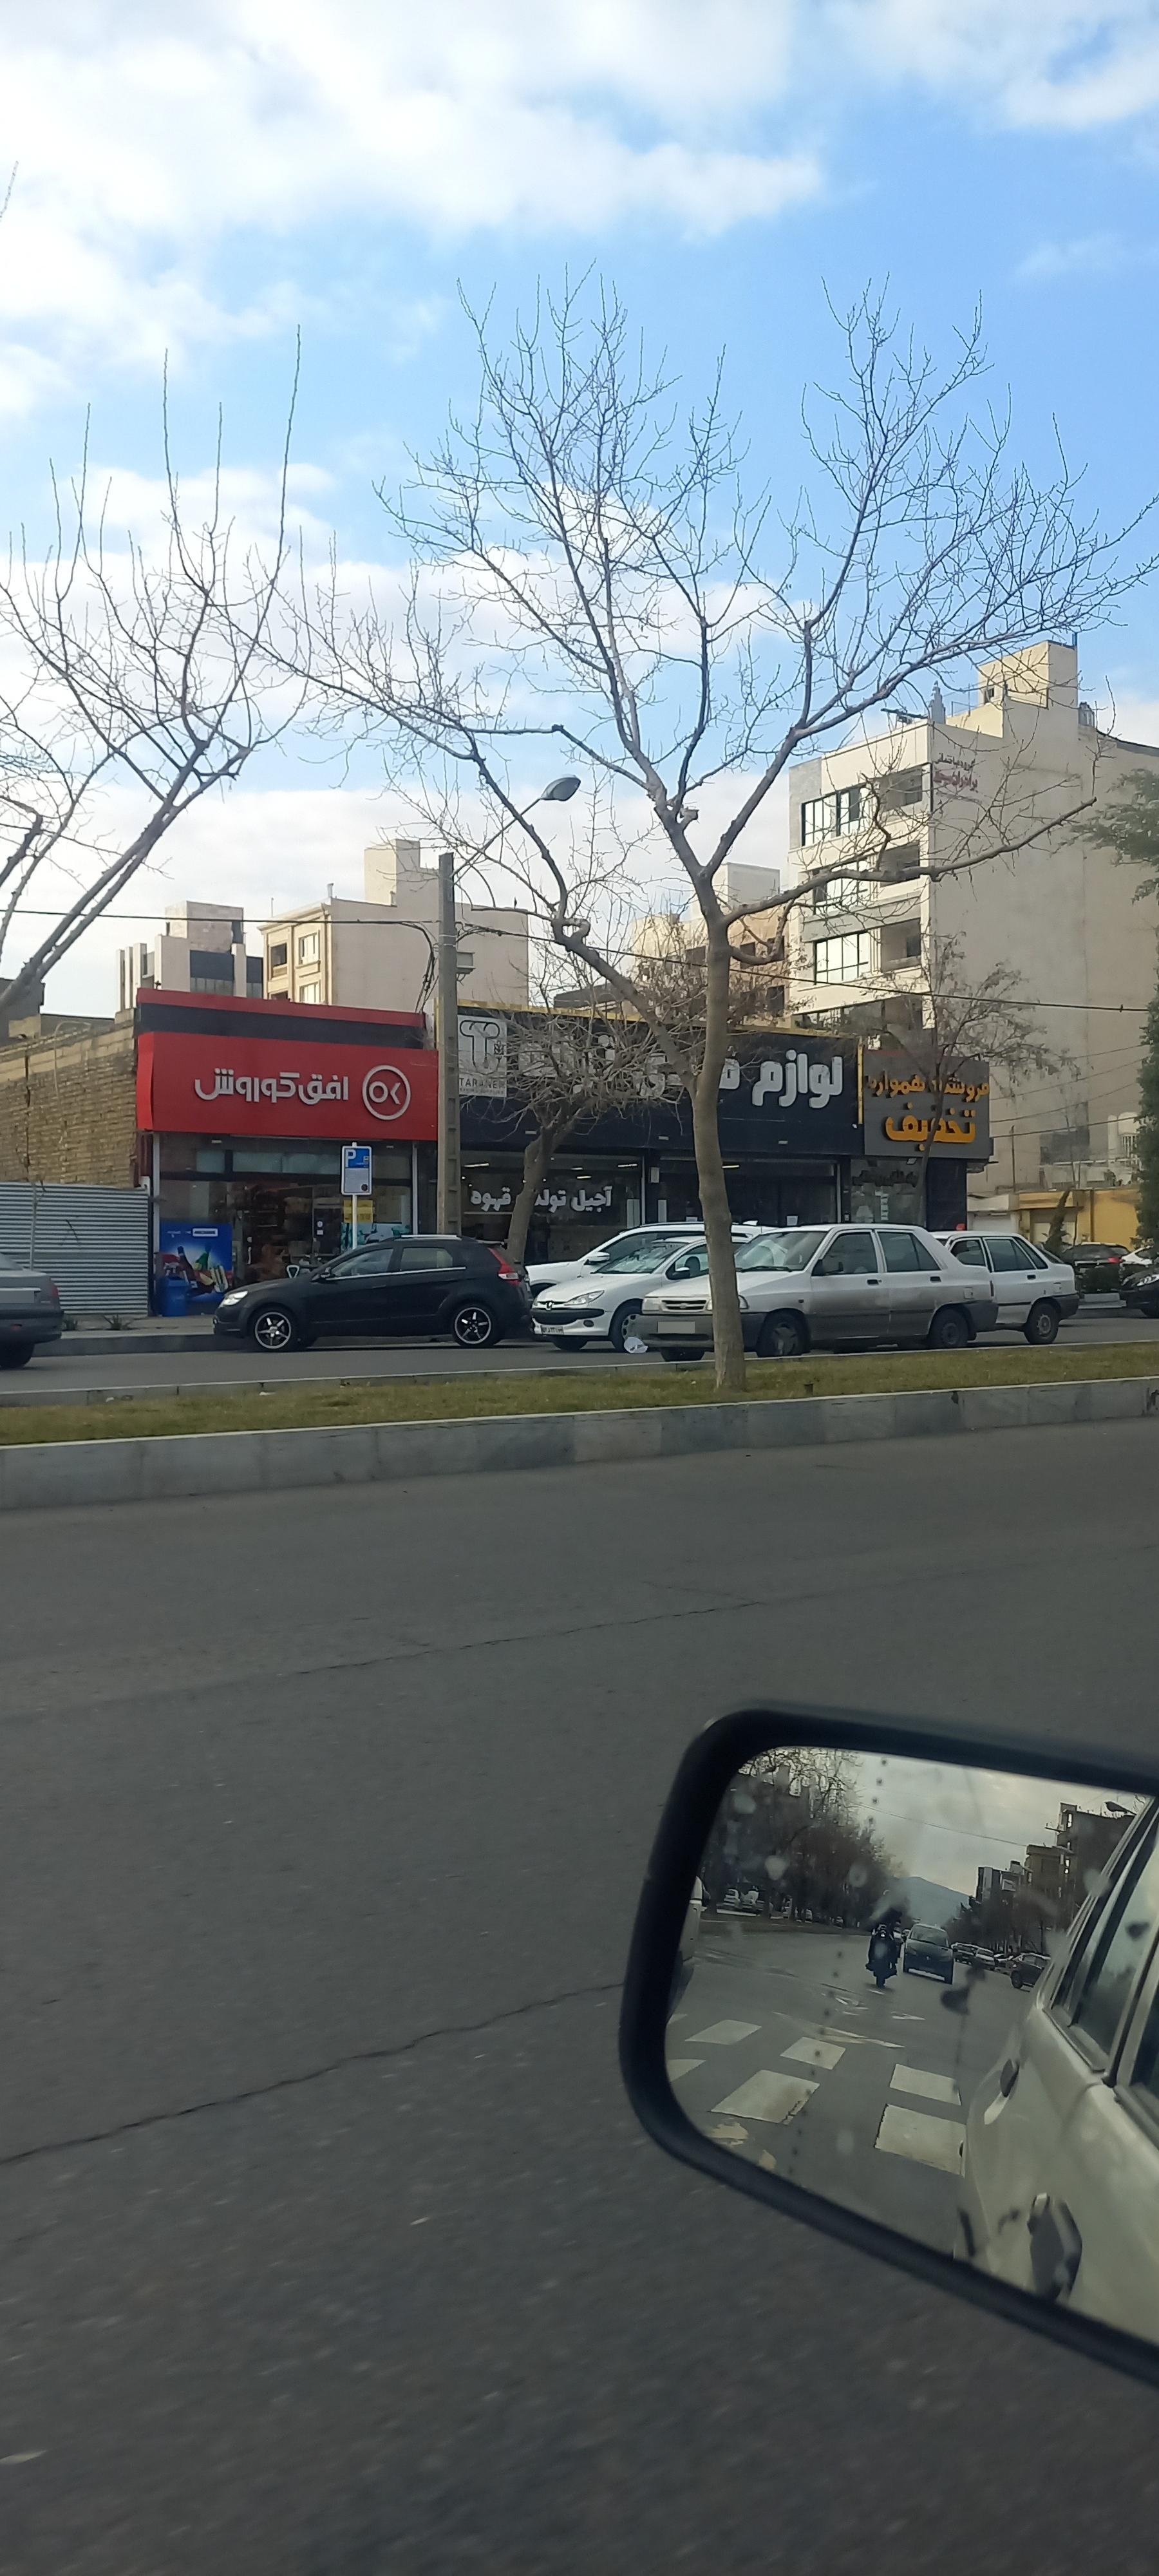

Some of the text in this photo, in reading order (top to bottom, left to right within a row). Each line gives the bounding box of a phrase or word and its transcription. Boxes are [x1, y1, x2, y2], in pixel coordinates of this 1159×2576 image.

[194, 1068, 349, 1105] افق کوروش
[458, 1077, 506, 1090] TARNE
[751, 1049, 843, 1108] لوازم
[932, 1071, 990, 1103] فروشا
[368, 1081, 401, 1105] OK
[345, 1149, 357, 1168] P
[470, 1186, 511, 1212] قهوه
[570, 1186, 613, 1212] آجیل
